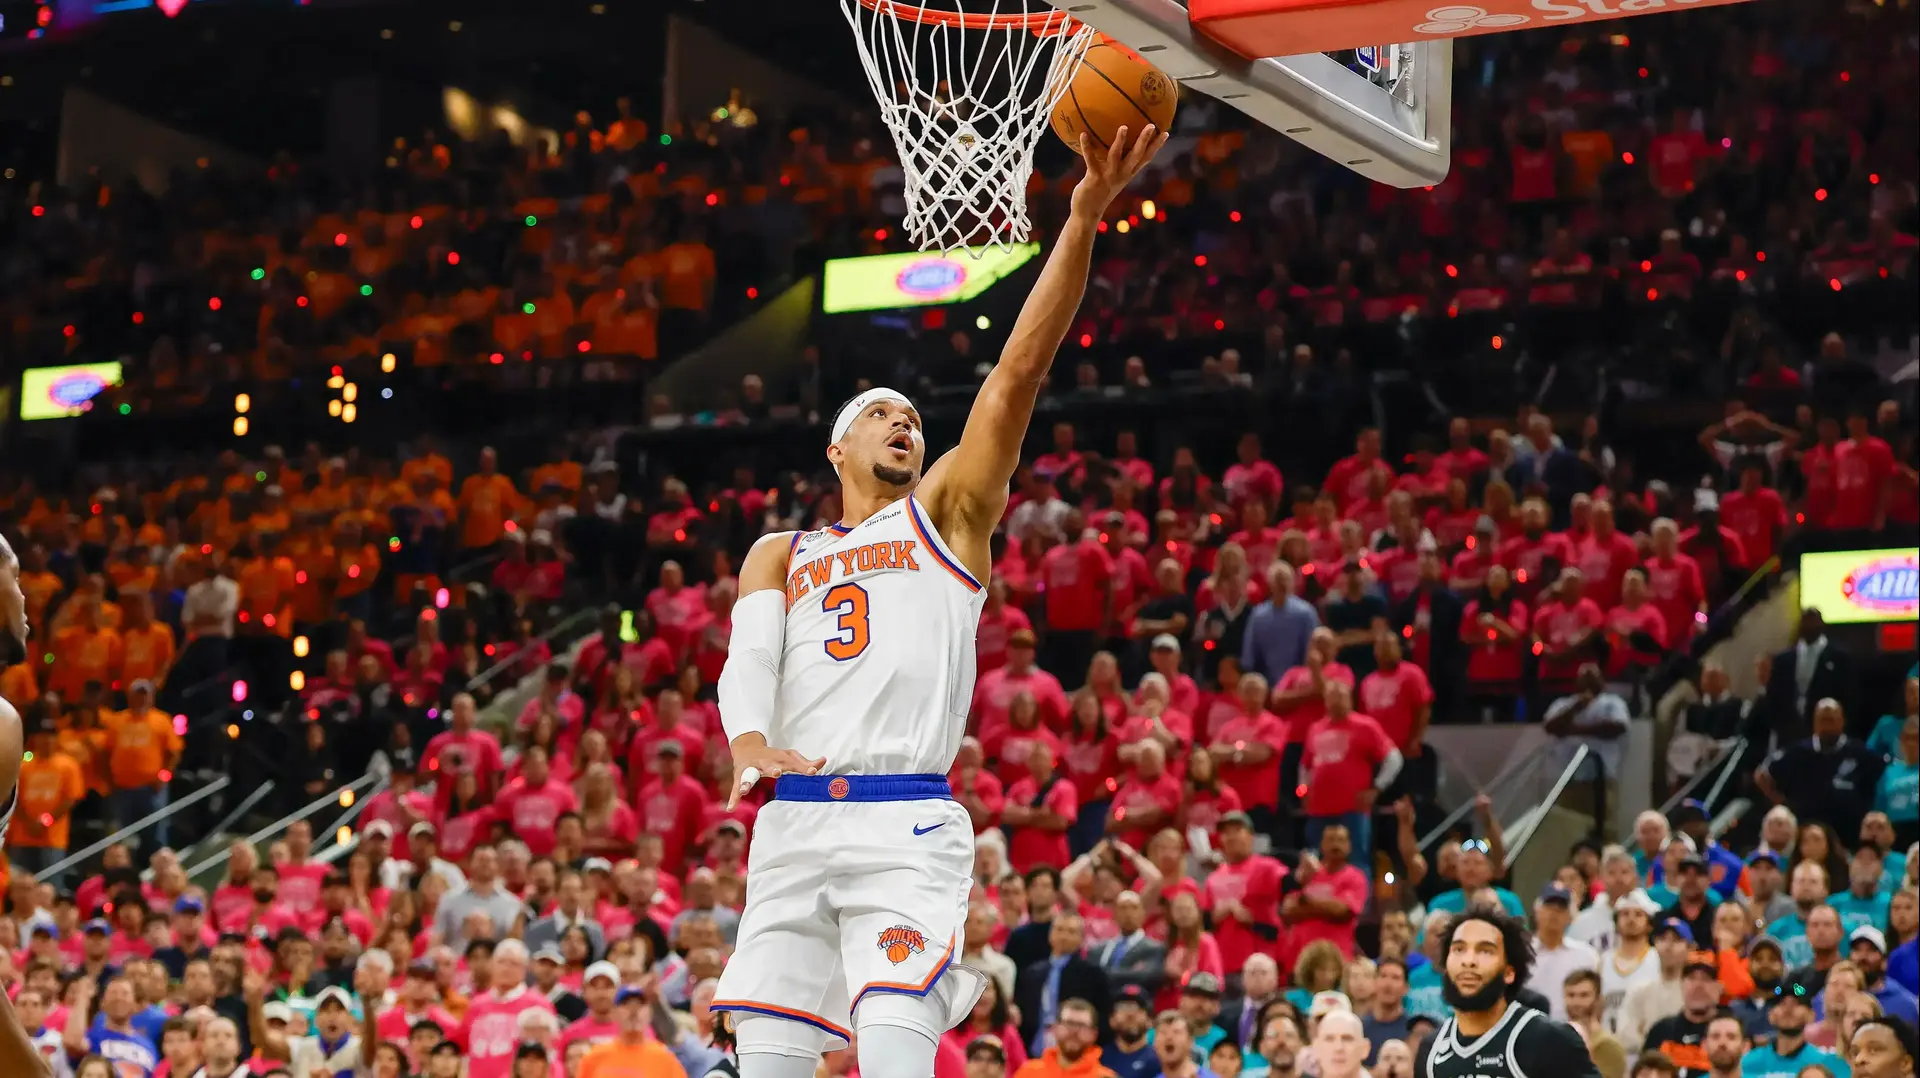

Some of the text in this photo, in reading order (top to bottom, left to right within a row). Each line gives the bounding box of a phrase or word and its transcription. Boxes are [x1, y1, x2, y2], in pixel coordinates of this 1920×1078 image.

[785, 540, 920, 616] NEW YORK
[821, 582, 870, 662] 3
[878, 927, 925, 951] KNICKS
